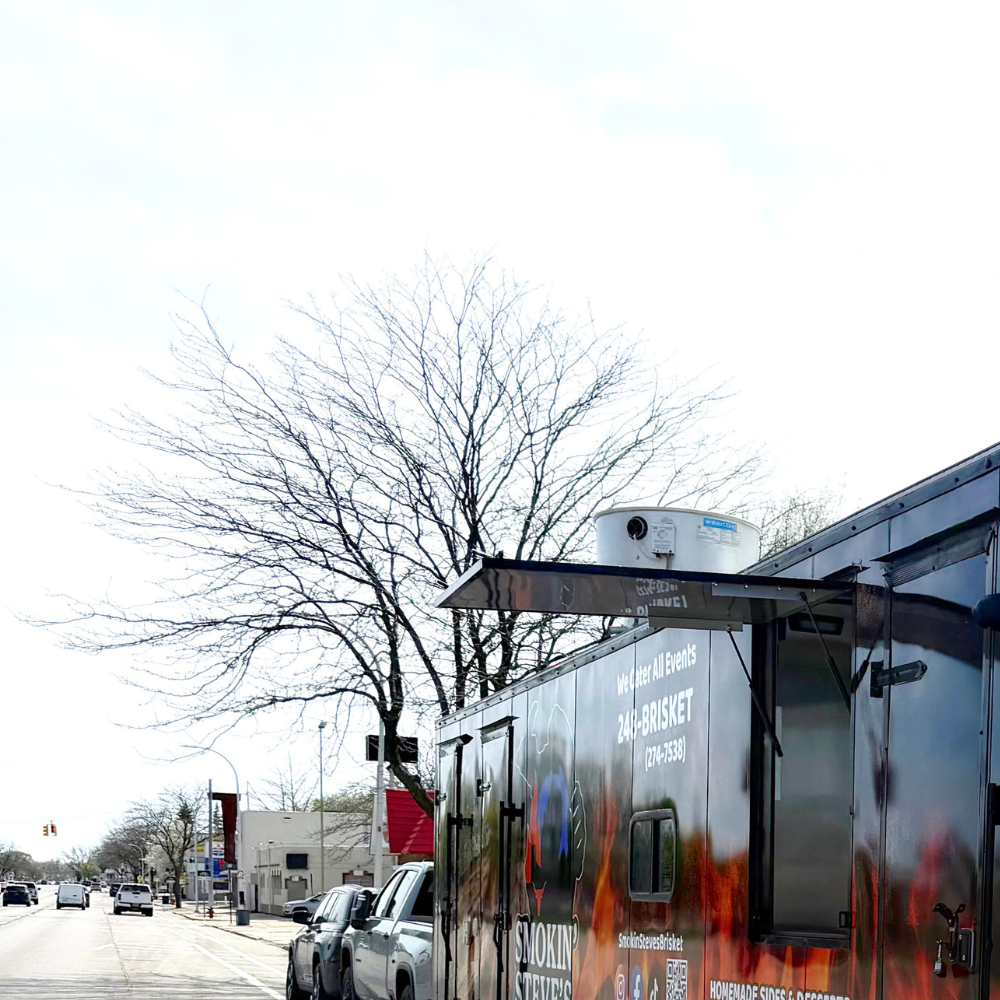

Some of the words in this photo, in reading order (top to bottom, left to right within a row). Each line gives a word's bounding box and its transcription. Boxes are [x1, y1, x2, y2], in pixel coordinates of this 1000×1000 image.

[617, 672, 629, 696] We
[629, 664, 651, 691] Cater
[652, 652, 664, 681] All
[665, 643, 697, 676] Events
[617, 687, 694, 744] 248-BRISKET
[645, 735, 686, 772] (274-7538)
[515, 920, 578, 972] SMOKIN'
[618, 931, 684, 952] SmokinStevesBrisket
